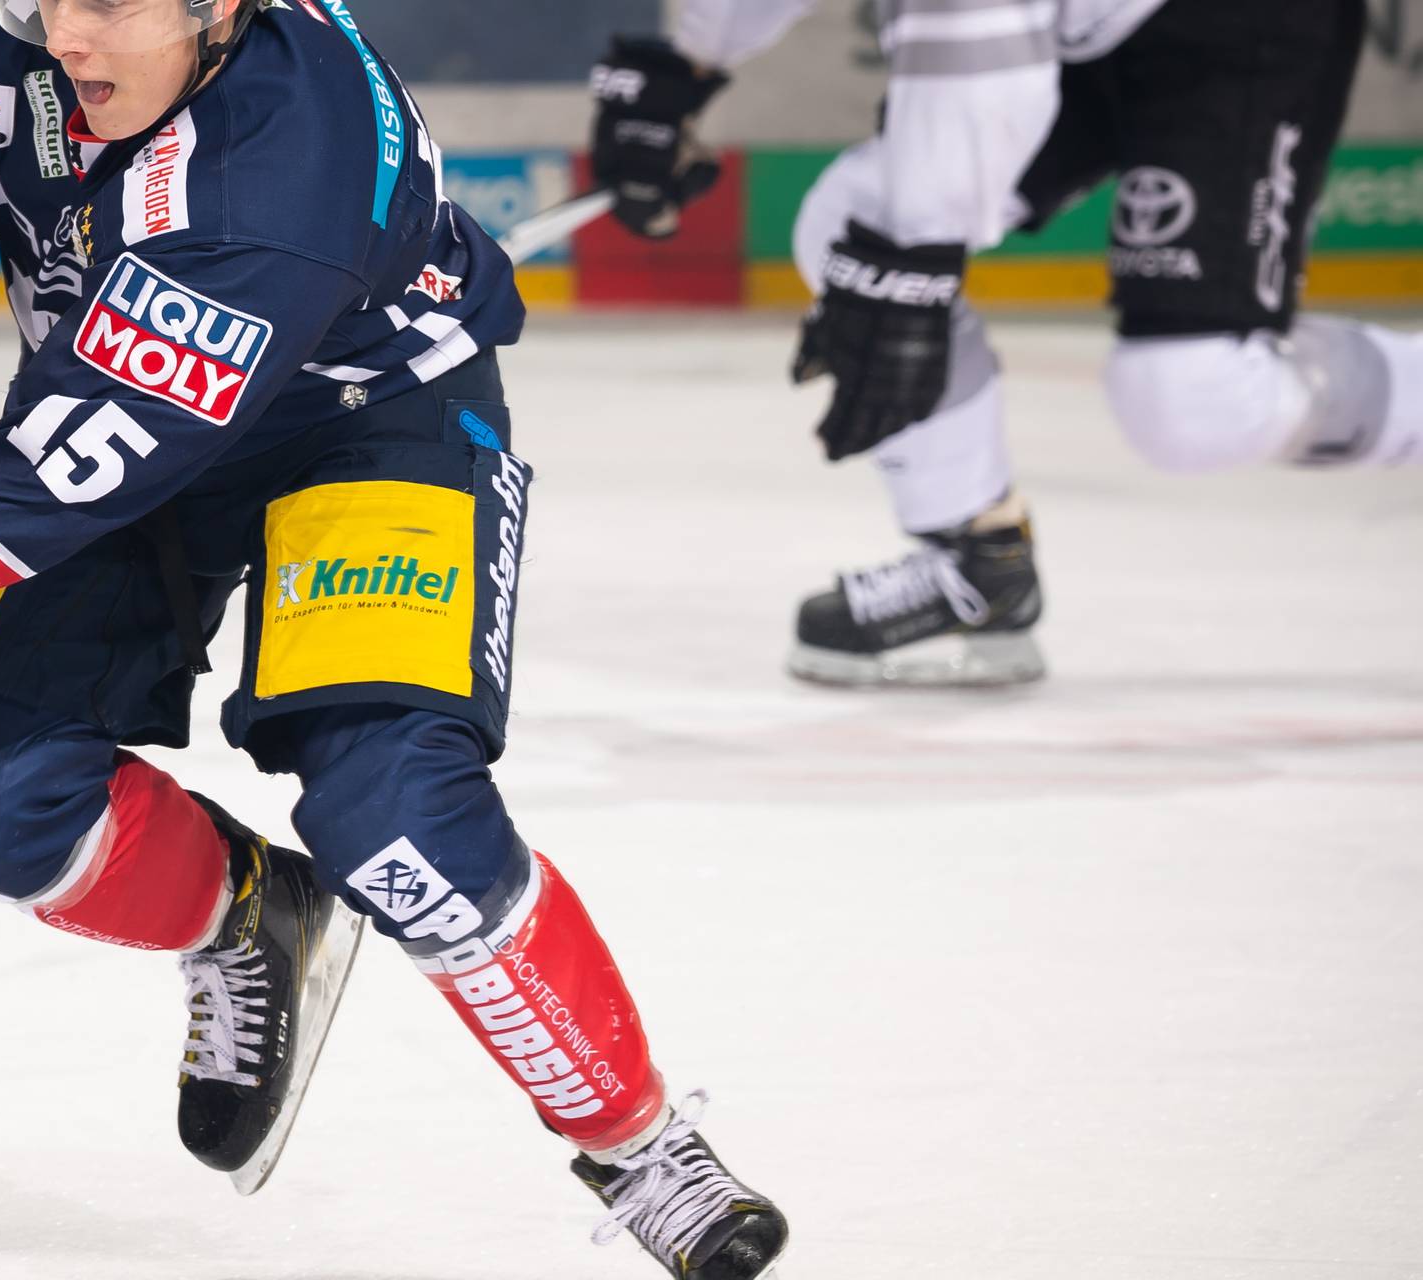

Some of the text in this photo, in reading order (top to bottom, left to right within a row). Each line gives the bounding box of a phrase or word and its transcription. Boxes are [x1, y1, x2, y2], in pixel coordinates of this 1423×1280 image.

[35, 71, 63, 177] structure
[83, 310, 244, 412] MOLY
[107, 261, 261, 366] LIQUI
[6, 394, 160, 504] 15
[309, 555, 459, 604] Knittel
[494, 933, 626, 1099] DACHTECHNIK OST
